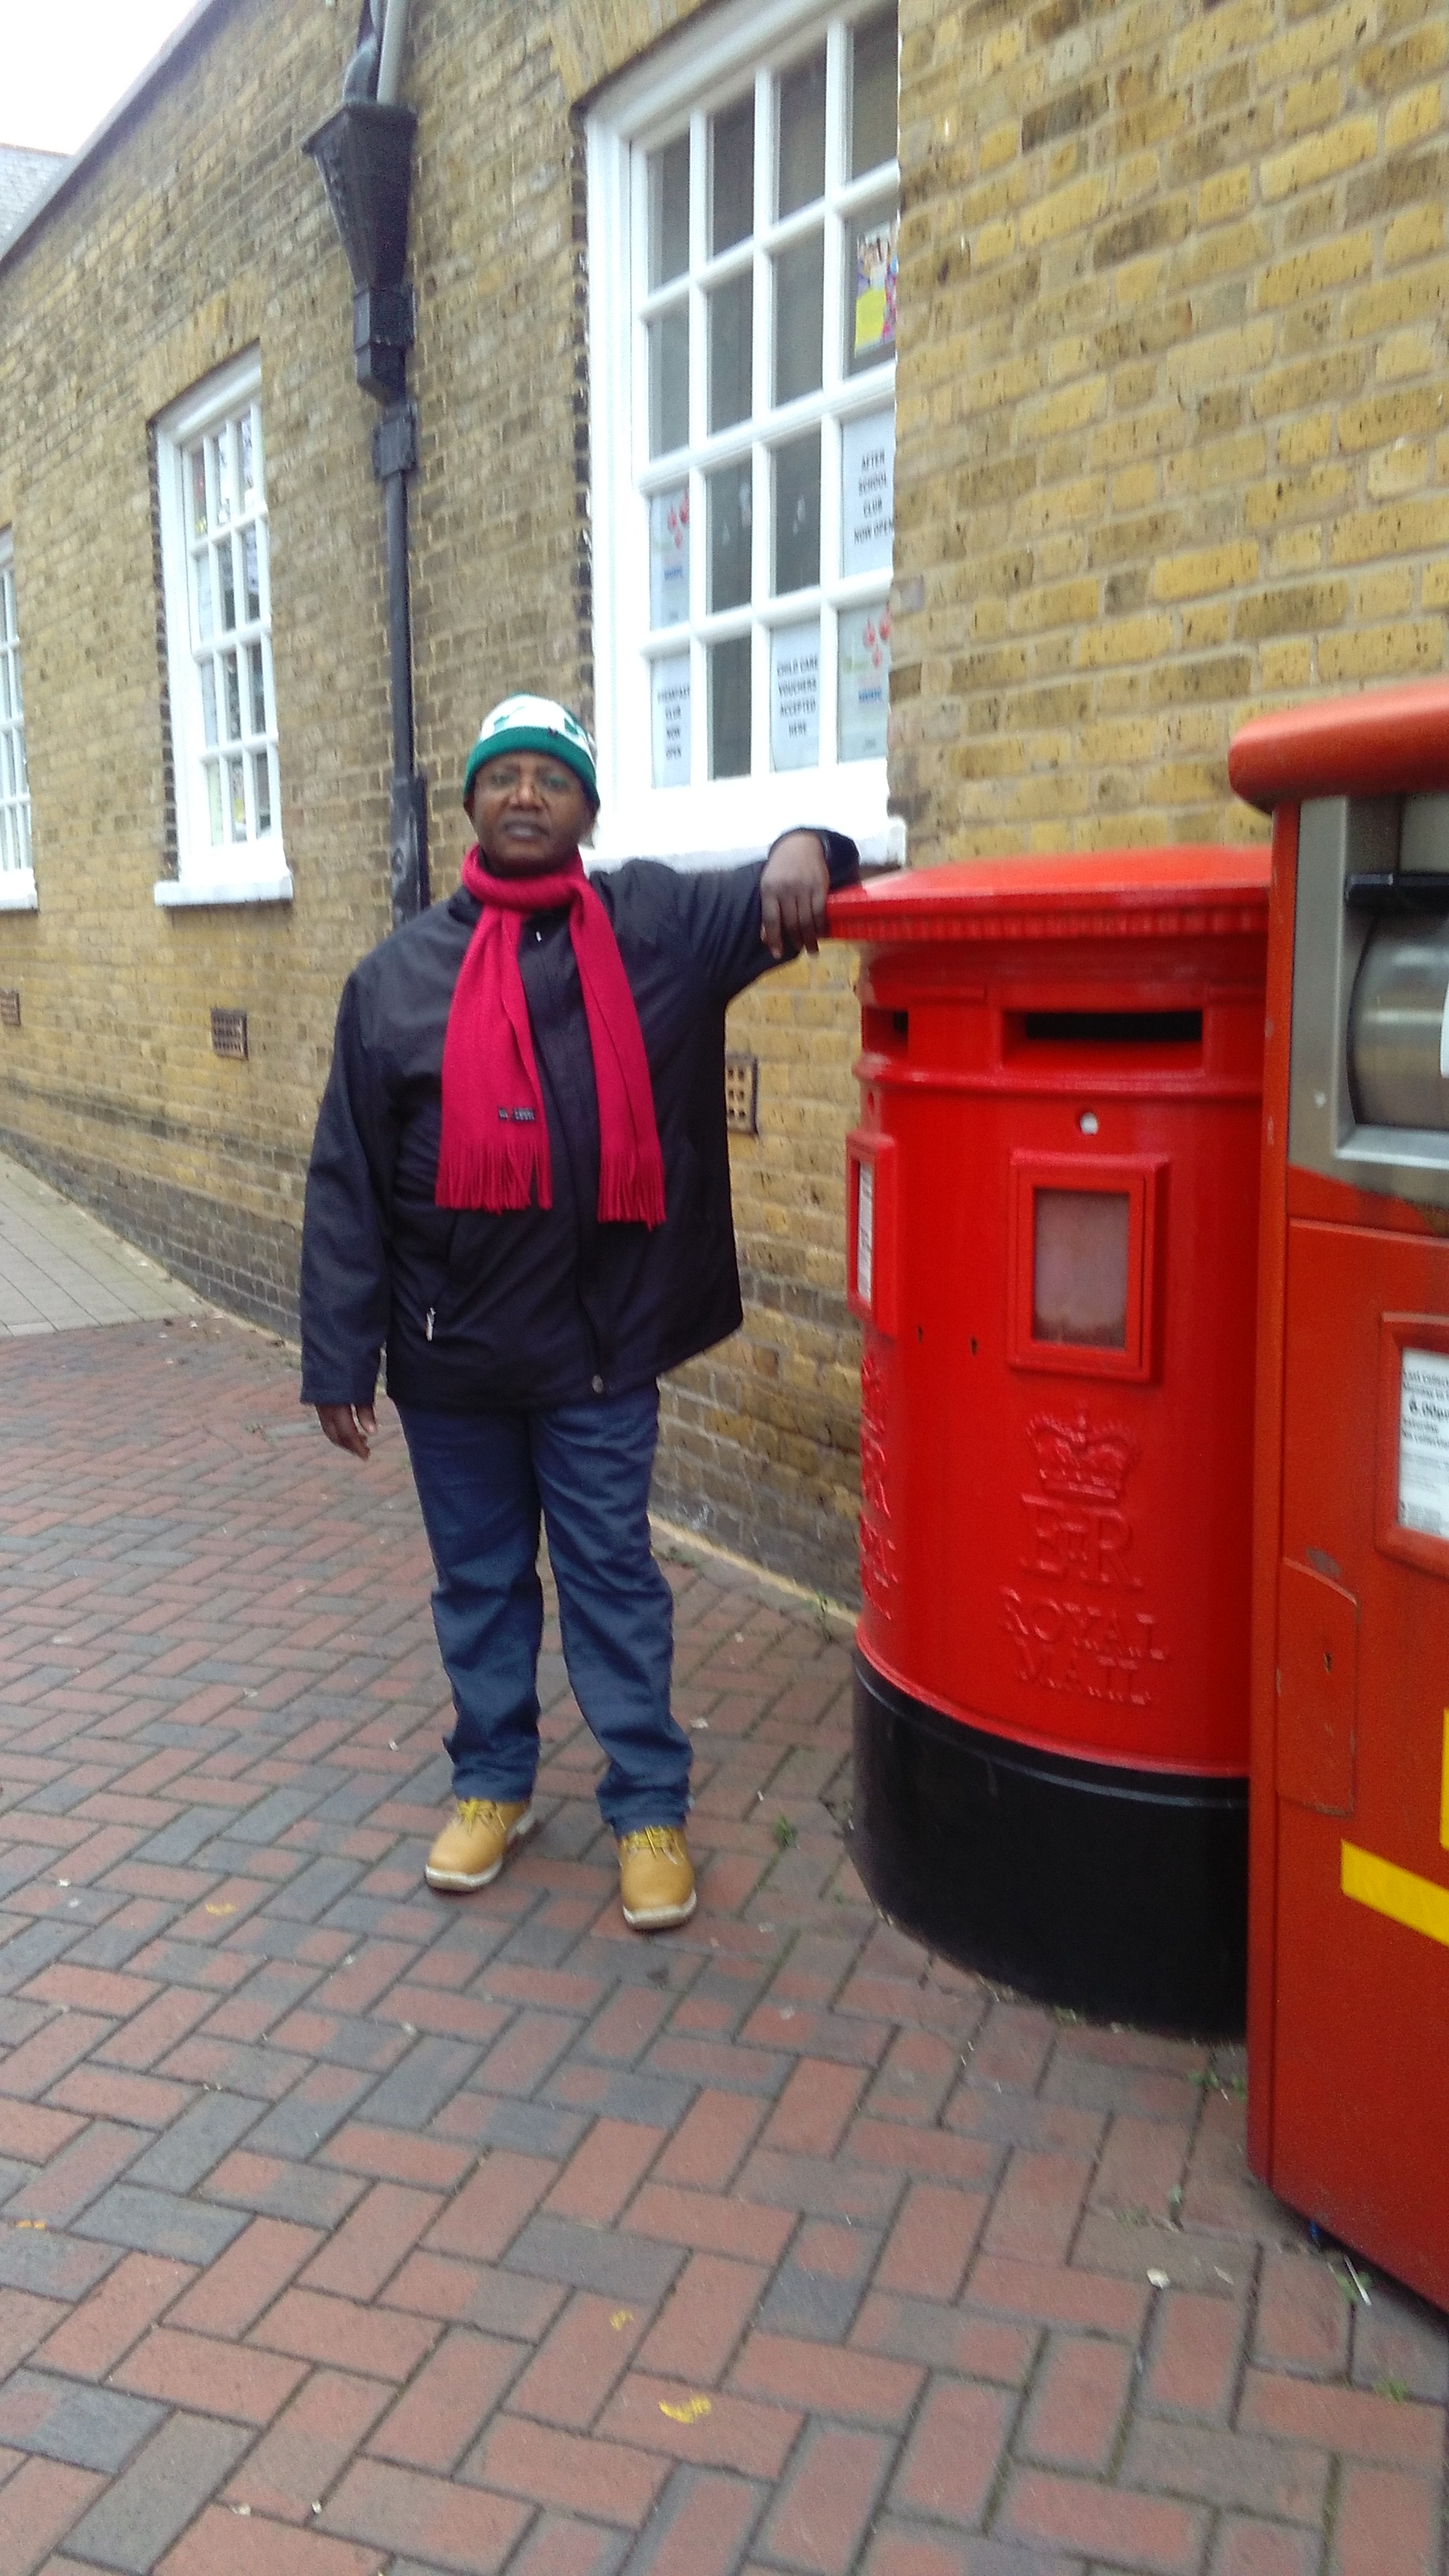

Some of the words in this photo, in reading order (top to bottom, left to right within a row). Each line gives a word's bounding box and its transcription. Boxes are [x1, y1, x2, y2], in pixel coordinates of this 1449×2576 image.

[862, 449, 885, 471] AFTER
[859, 471, 887, 496] SCHOOL
[863, 495, 882, 519] CLUB
[854, 524, 871, 545] NOW
[778, 676, 817, 697] VOUCHERS
[781, 697, 816, 717] ACCEPTED
[999, 1584, 1170, 1661] ROYAL
[1014, 1635, 1152, 1707] MAIL
